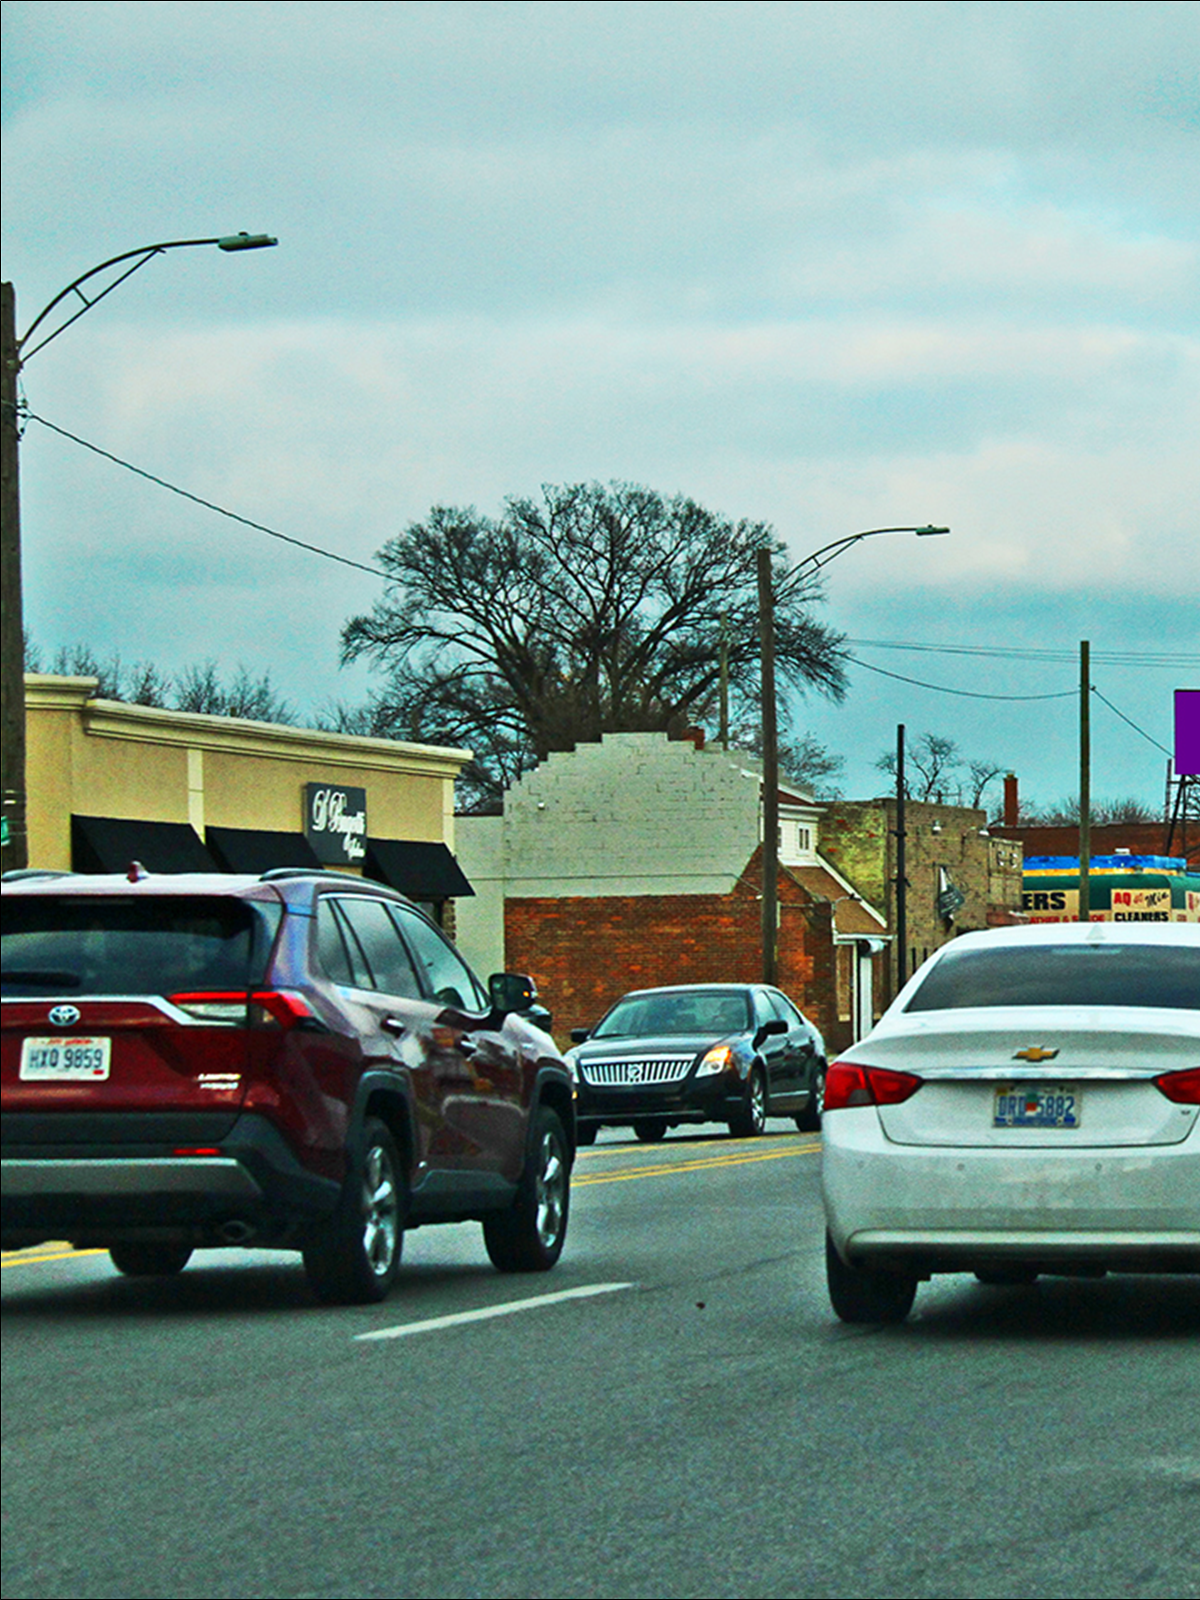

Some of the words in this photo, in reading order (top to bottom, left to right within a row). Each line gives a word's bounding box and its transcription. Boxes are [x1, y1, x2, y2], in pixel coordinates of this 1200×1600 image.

[1022, 892, 1066, 910] ERS
[1114, 911, 1169, 922] CLEANERS
[63, 1048, 104, 1069] 9859
[1037, 1095, 1075, 1117] 5882
